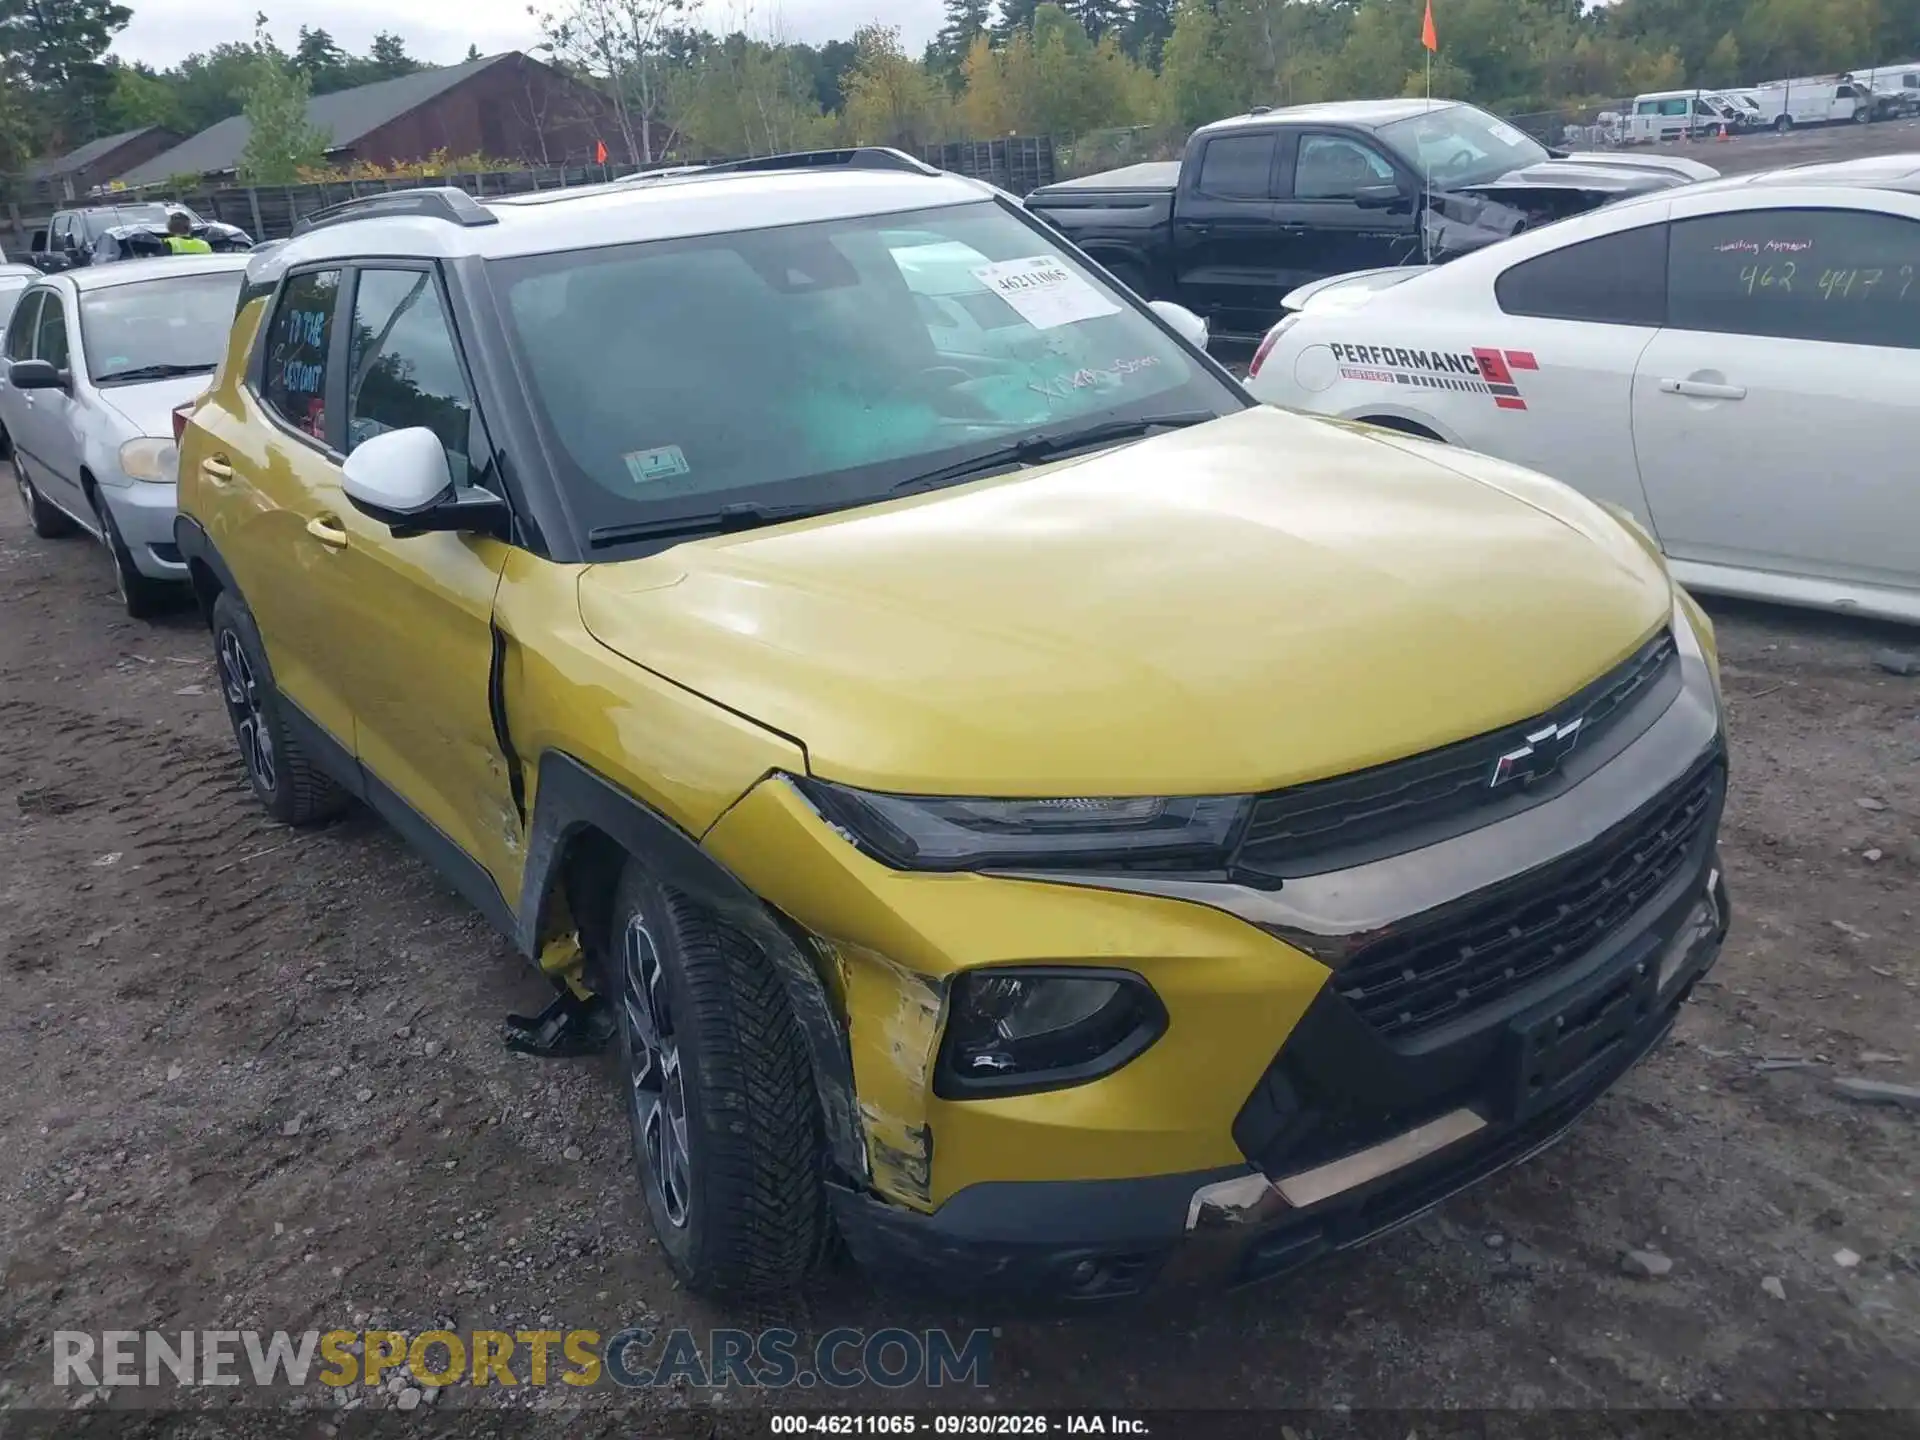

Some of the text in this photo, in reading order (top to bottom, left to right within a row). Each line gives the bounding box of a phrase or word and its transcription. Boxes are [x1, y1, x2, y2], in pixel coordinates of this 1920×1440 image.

[997, 268, 1069, 291] 46211065
[1739, 261, 1796, 297] 462
[1330, 342, 1498, 377] PERFORMANCE
